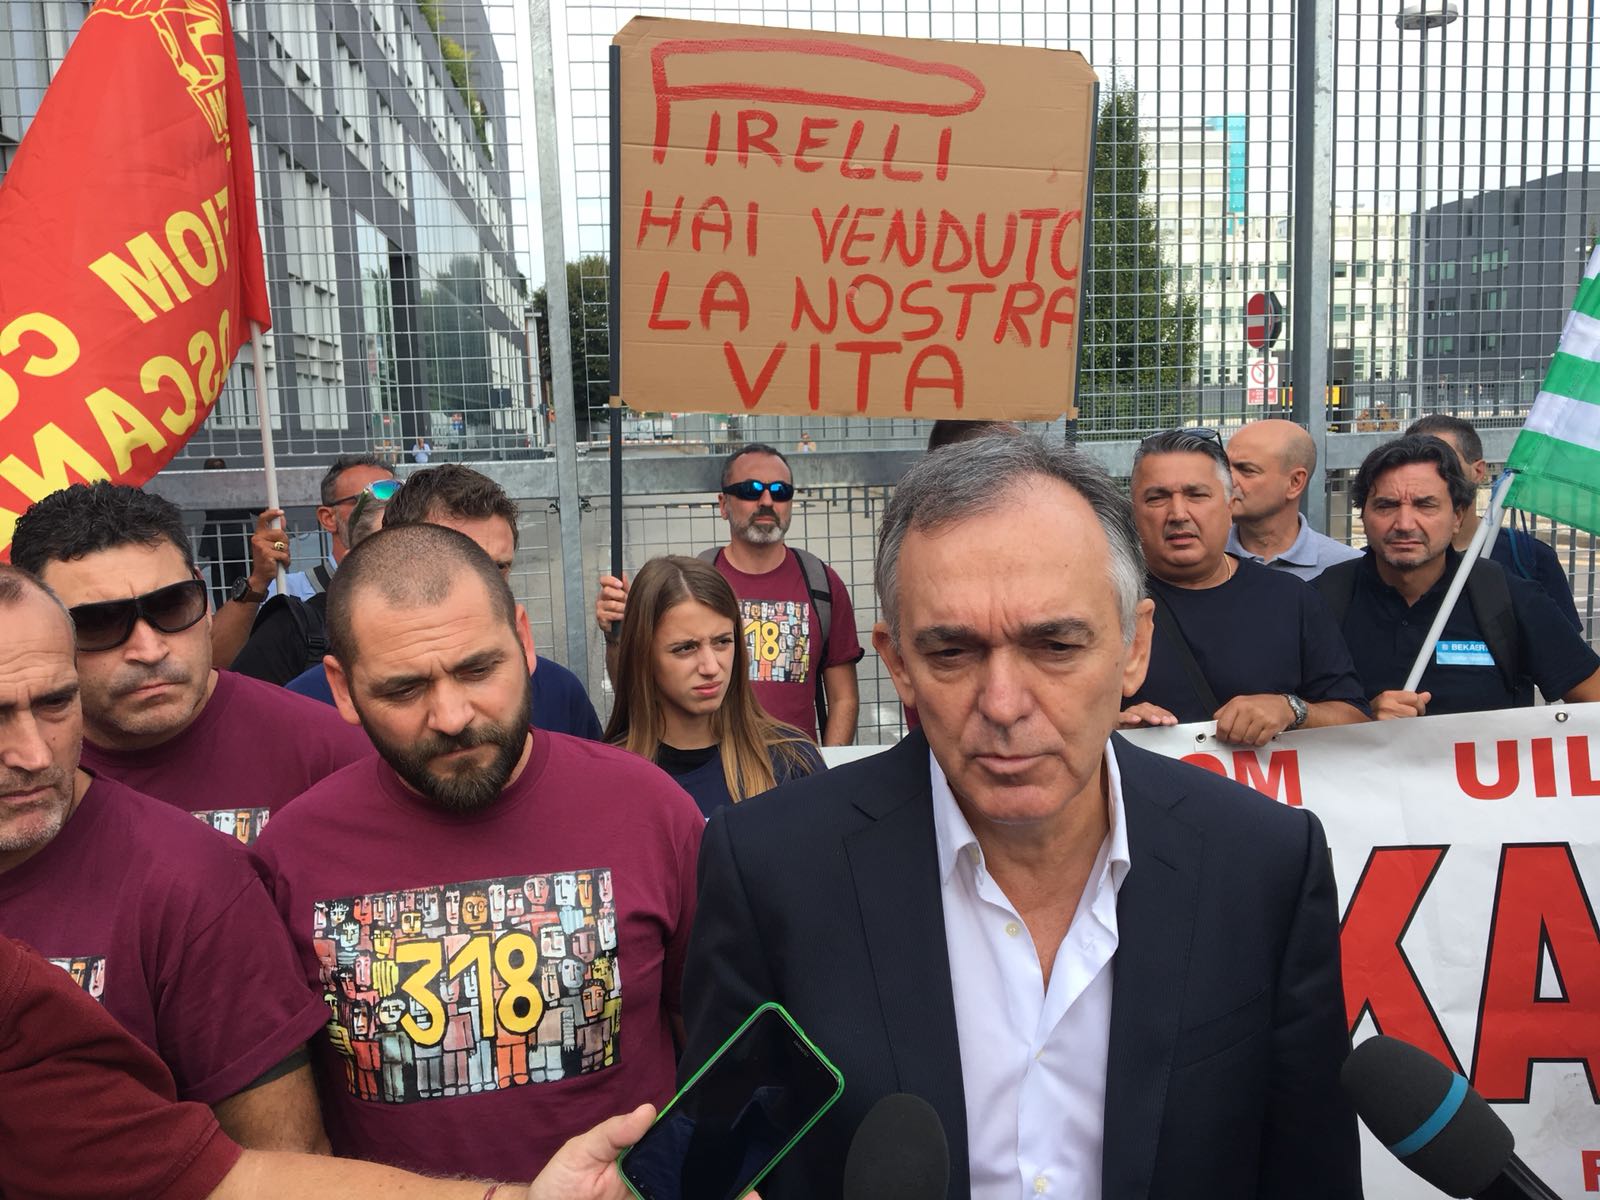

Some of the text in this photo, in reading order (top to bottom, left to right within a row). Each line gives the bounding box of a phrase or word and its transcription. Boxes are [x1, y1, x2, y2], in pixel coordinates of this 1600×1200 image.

[651, 38, 986, 182] PIRELLI
[637, 190, 759, 257] HAI
[648, 271, 1076, 348] LA NOSTRA
[724, 341, 963, 412] VITA
[396, 933, 543, 1045] 318
